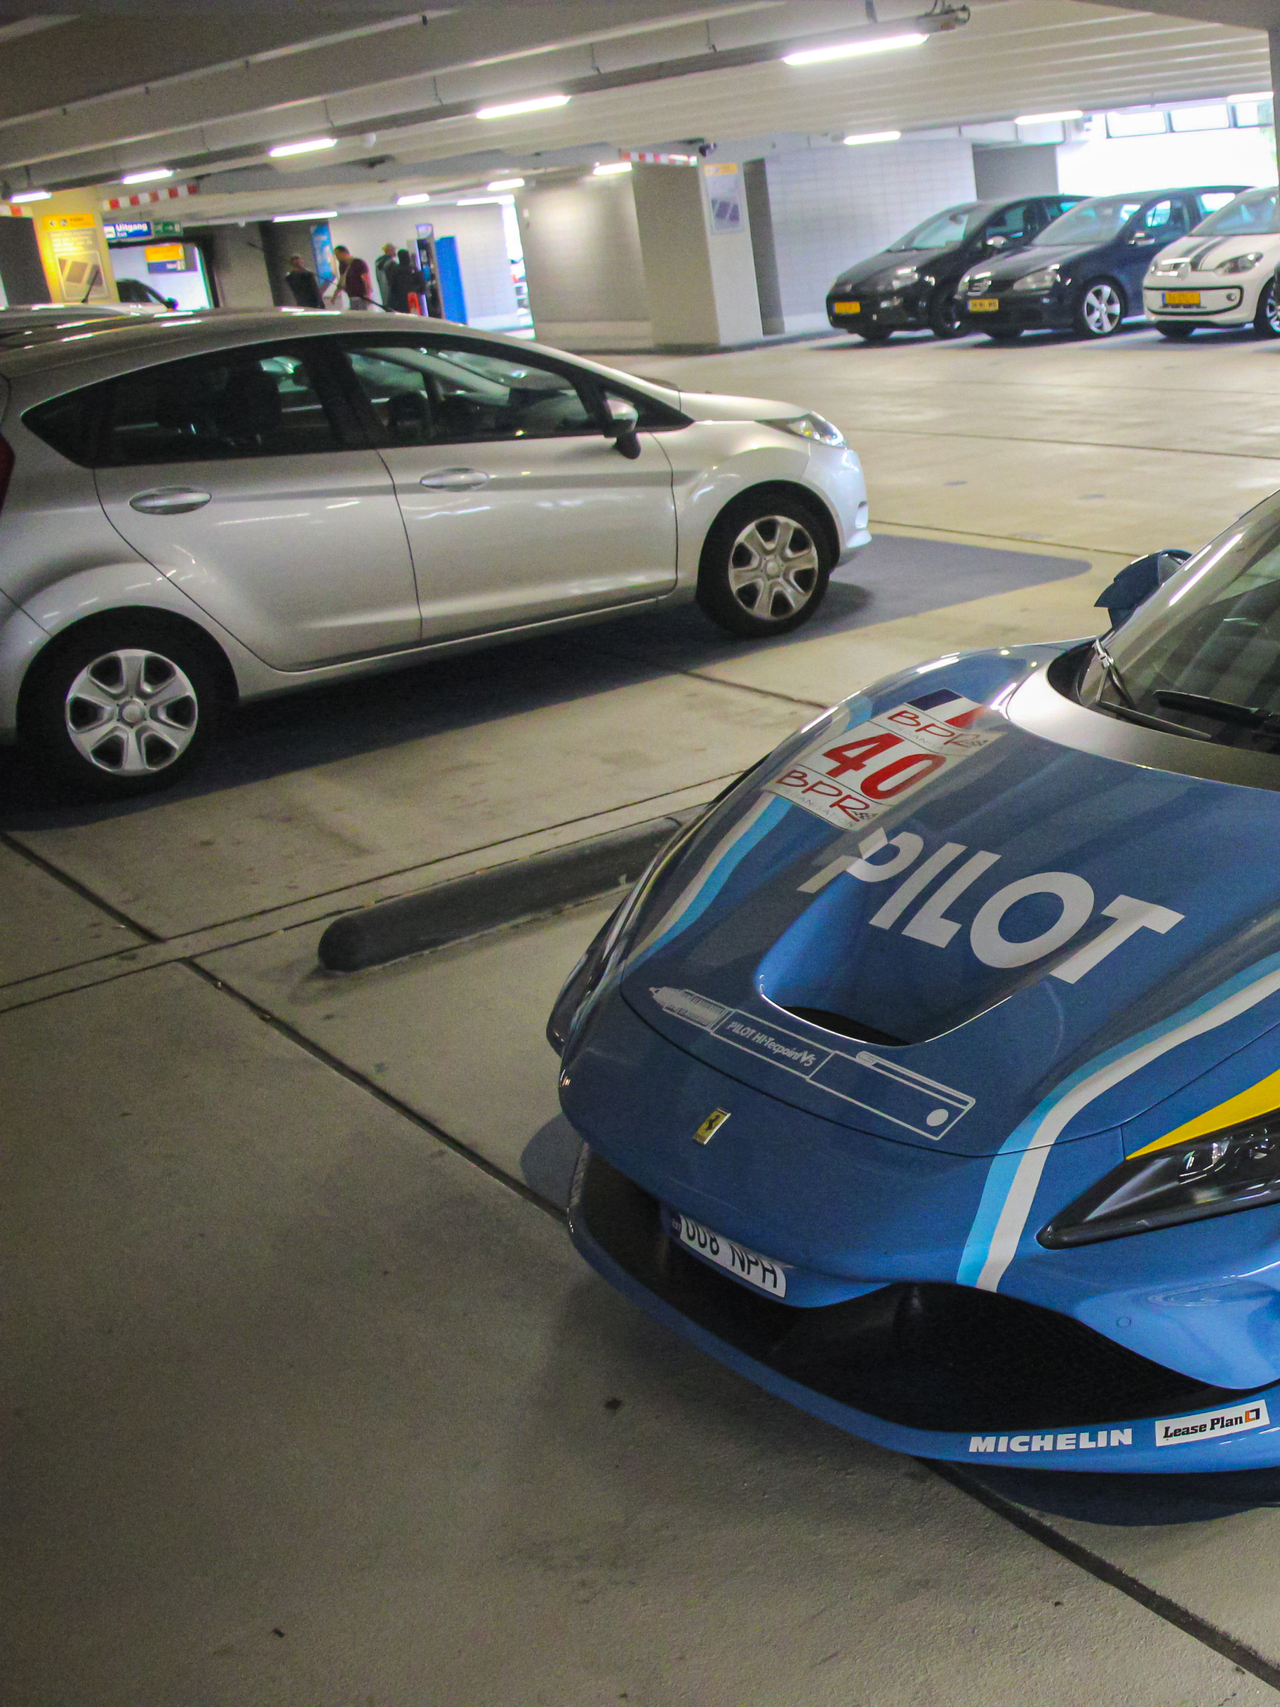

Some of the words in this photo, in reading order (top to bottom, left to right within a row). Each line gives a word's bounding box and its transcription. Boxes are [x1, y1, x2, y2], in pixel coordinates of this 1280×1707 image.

[115, 222, 148, 234] Uitgang
[887, 710, 980, 748] BPR
[821, 733, 947, 800] 40
[776, 769, 870, 822] BPR
[796, 827, 1186, 984] PILOT
[726, 1021, 756, 1038] PILOT
[728, 1243, 778, 1289] NPH
[968, 1428, 1133, 1453] MICHELIN
[1162, 1422, 1207, 1440] Lease
[1209, 1414, 1244, 1432] Plan
